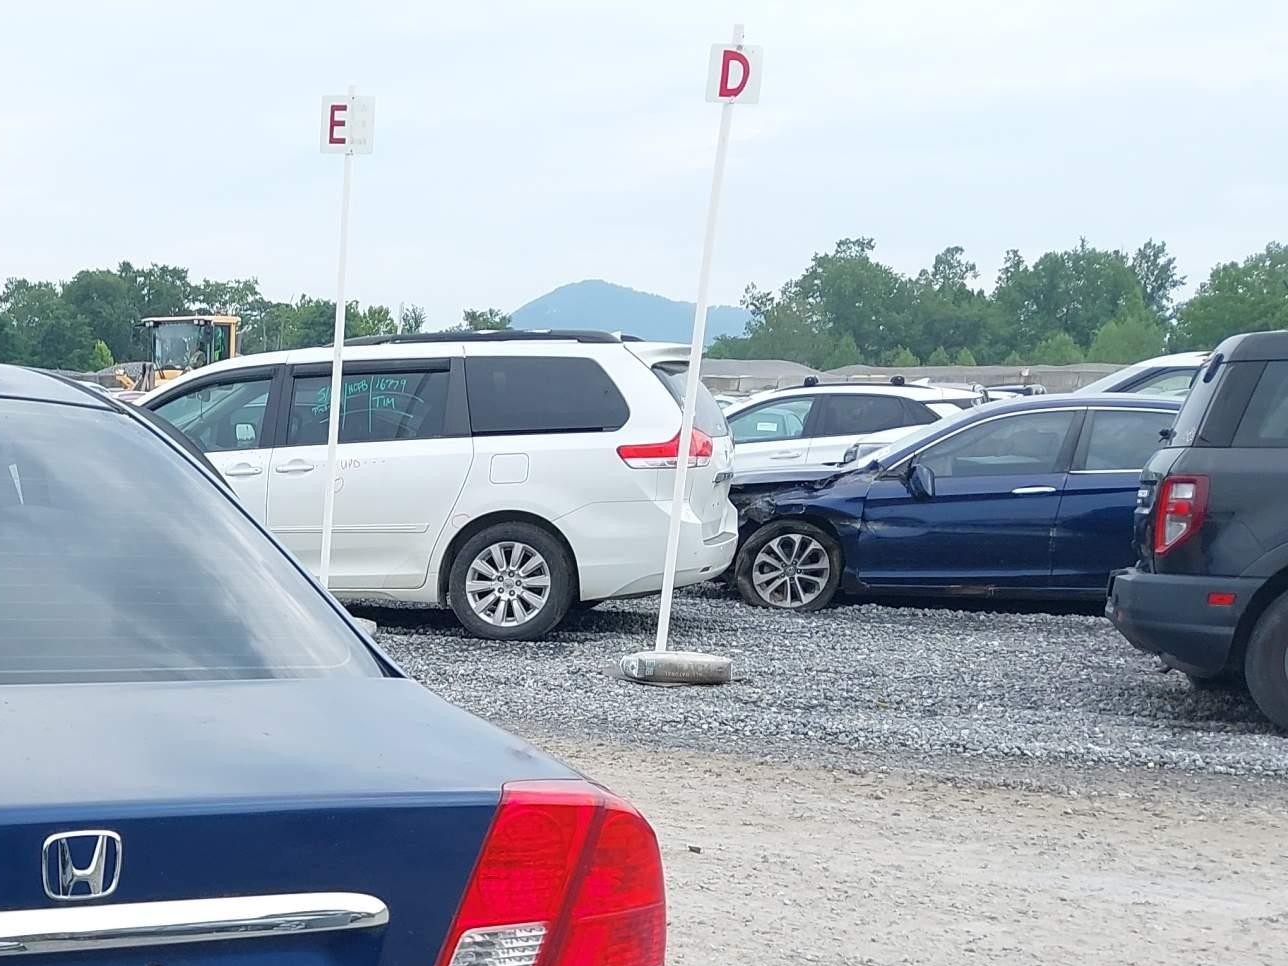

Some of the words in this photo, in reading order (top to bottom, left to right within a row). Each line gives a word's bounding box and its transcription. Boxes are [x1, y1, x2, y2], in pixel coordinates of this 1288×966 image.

[718, 49, 750, 97] D
[328, 104, 348, 145] E
[372, 395, 396, 409] TIM
